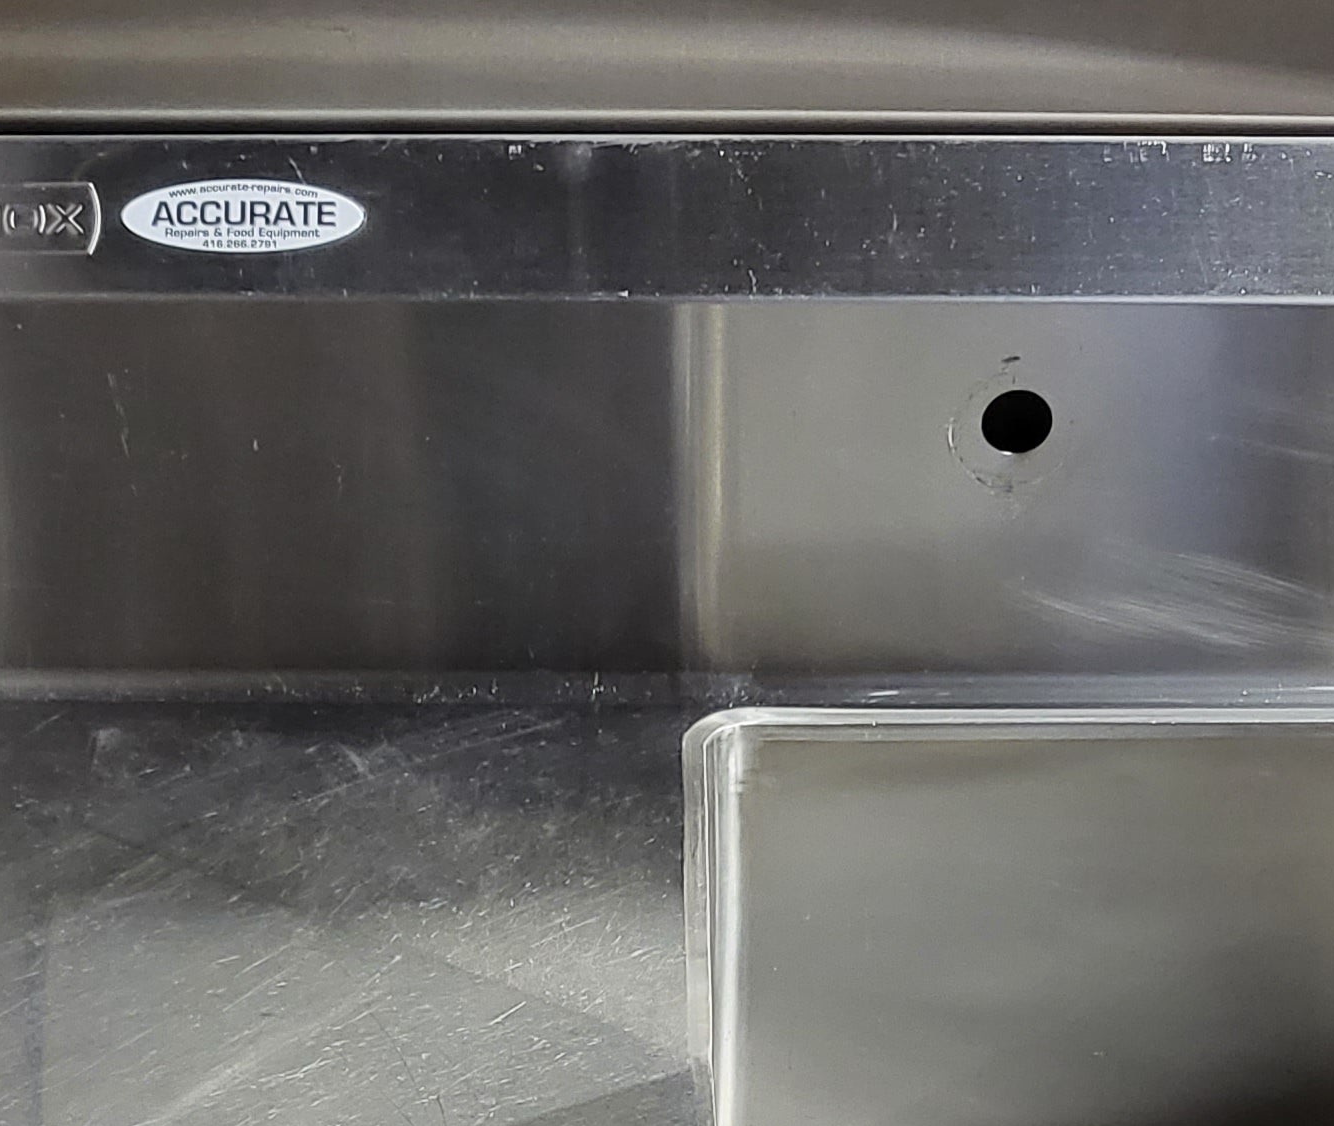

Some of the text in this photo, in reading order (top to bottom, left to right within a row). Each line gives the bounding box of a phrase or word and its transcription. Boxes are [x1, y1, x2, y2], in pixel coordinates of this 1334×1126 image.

[169, 183, 317, 199] www.accurate-repairs.com
[151, 200, 336, 226] ACCURATE
[165, 227, 320, 239] Repairs & Food Equipment
